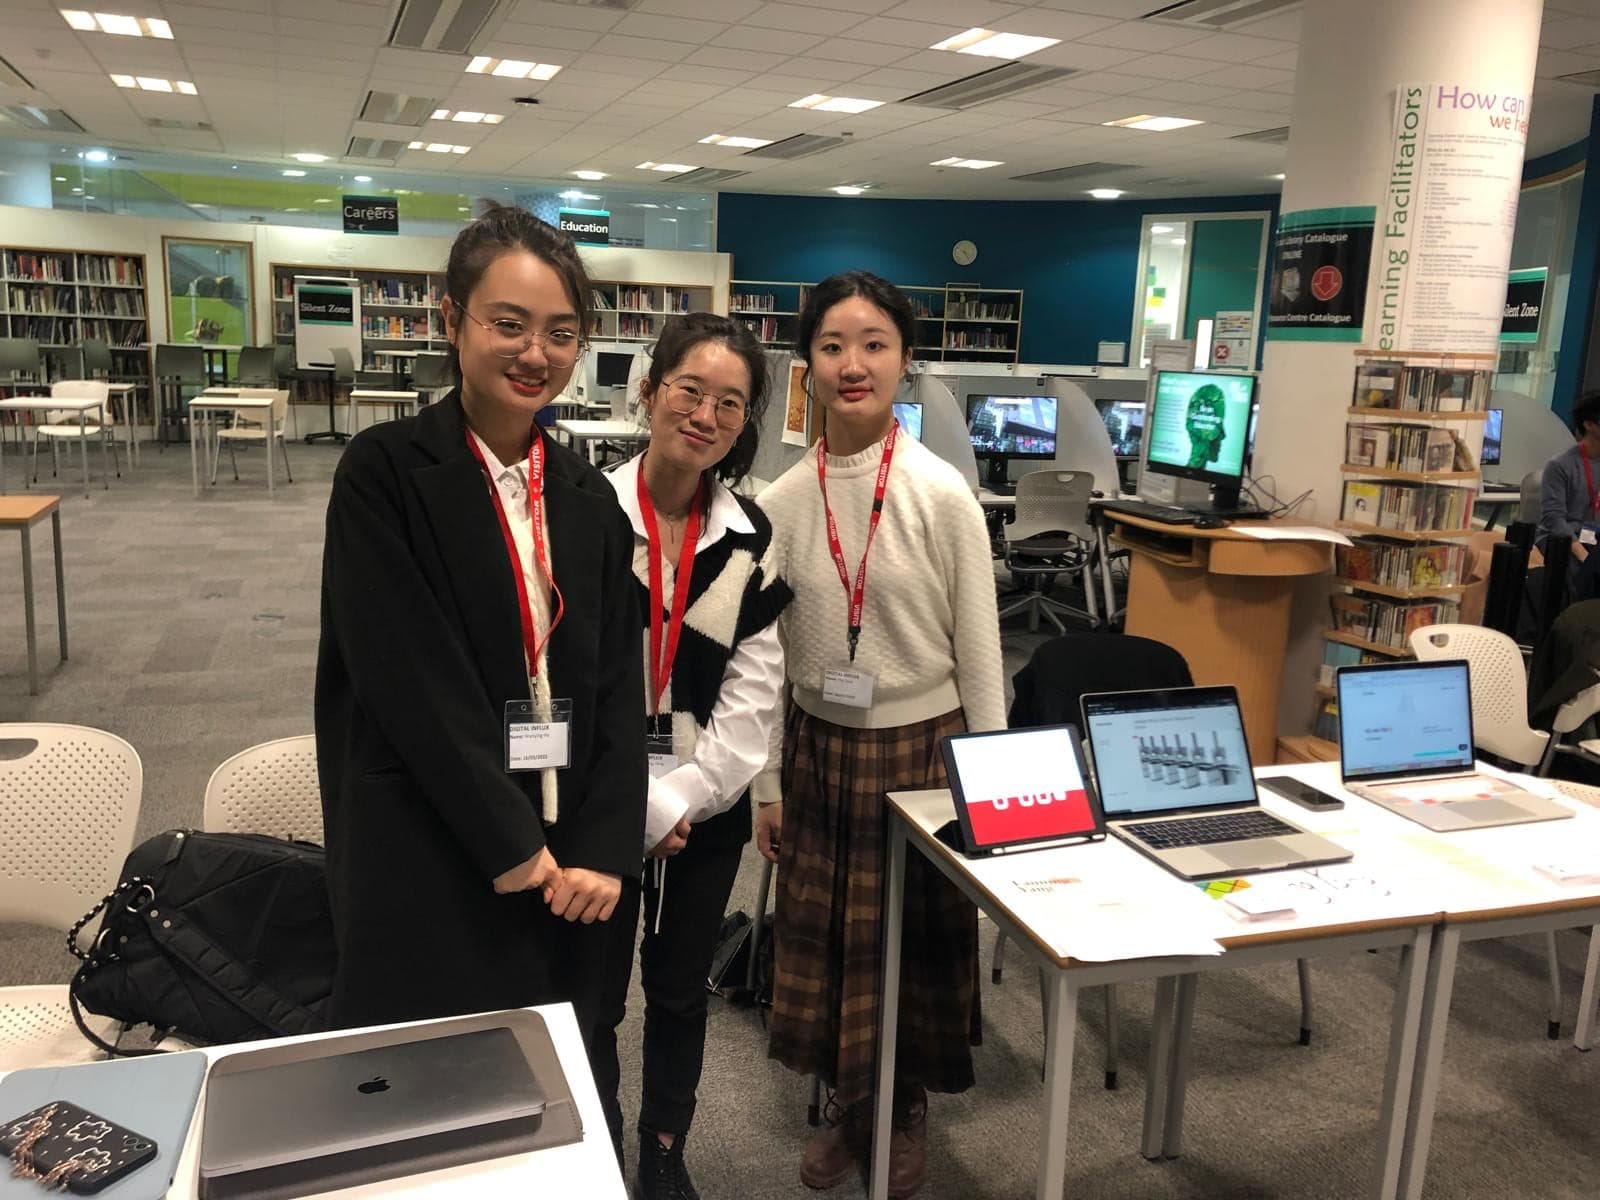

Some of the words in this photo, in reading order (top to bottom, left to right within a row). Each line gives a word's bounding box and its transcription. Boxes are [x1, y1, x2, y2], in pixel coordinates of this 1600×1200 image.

[1437, 85, 1497, 109] How
[1503, 96, 1525, 115] can
[1489, 115, 1511, 130] we
[1386, 87, 1422, 238] Facilitators
[343, 205, 395, 220] Careers
[560, 220, 609, 234] Education
[1304, 232, 1349, 244] Catalogue
[300, 302, 327, 313] Silent
[328, 303, 351, 314] Zone
[1379, 249, 1409, 353] earning
[1520, 302, 1539, 317] Zone
[1309, 313, 1352, 324] Catalogue
[532, 445, 541, 480] VISITO
[878, 462, 888, 488] VISITOR
[534, 500, 543, 541] VISITOR
[852, 604, 861, 627] VISITO
